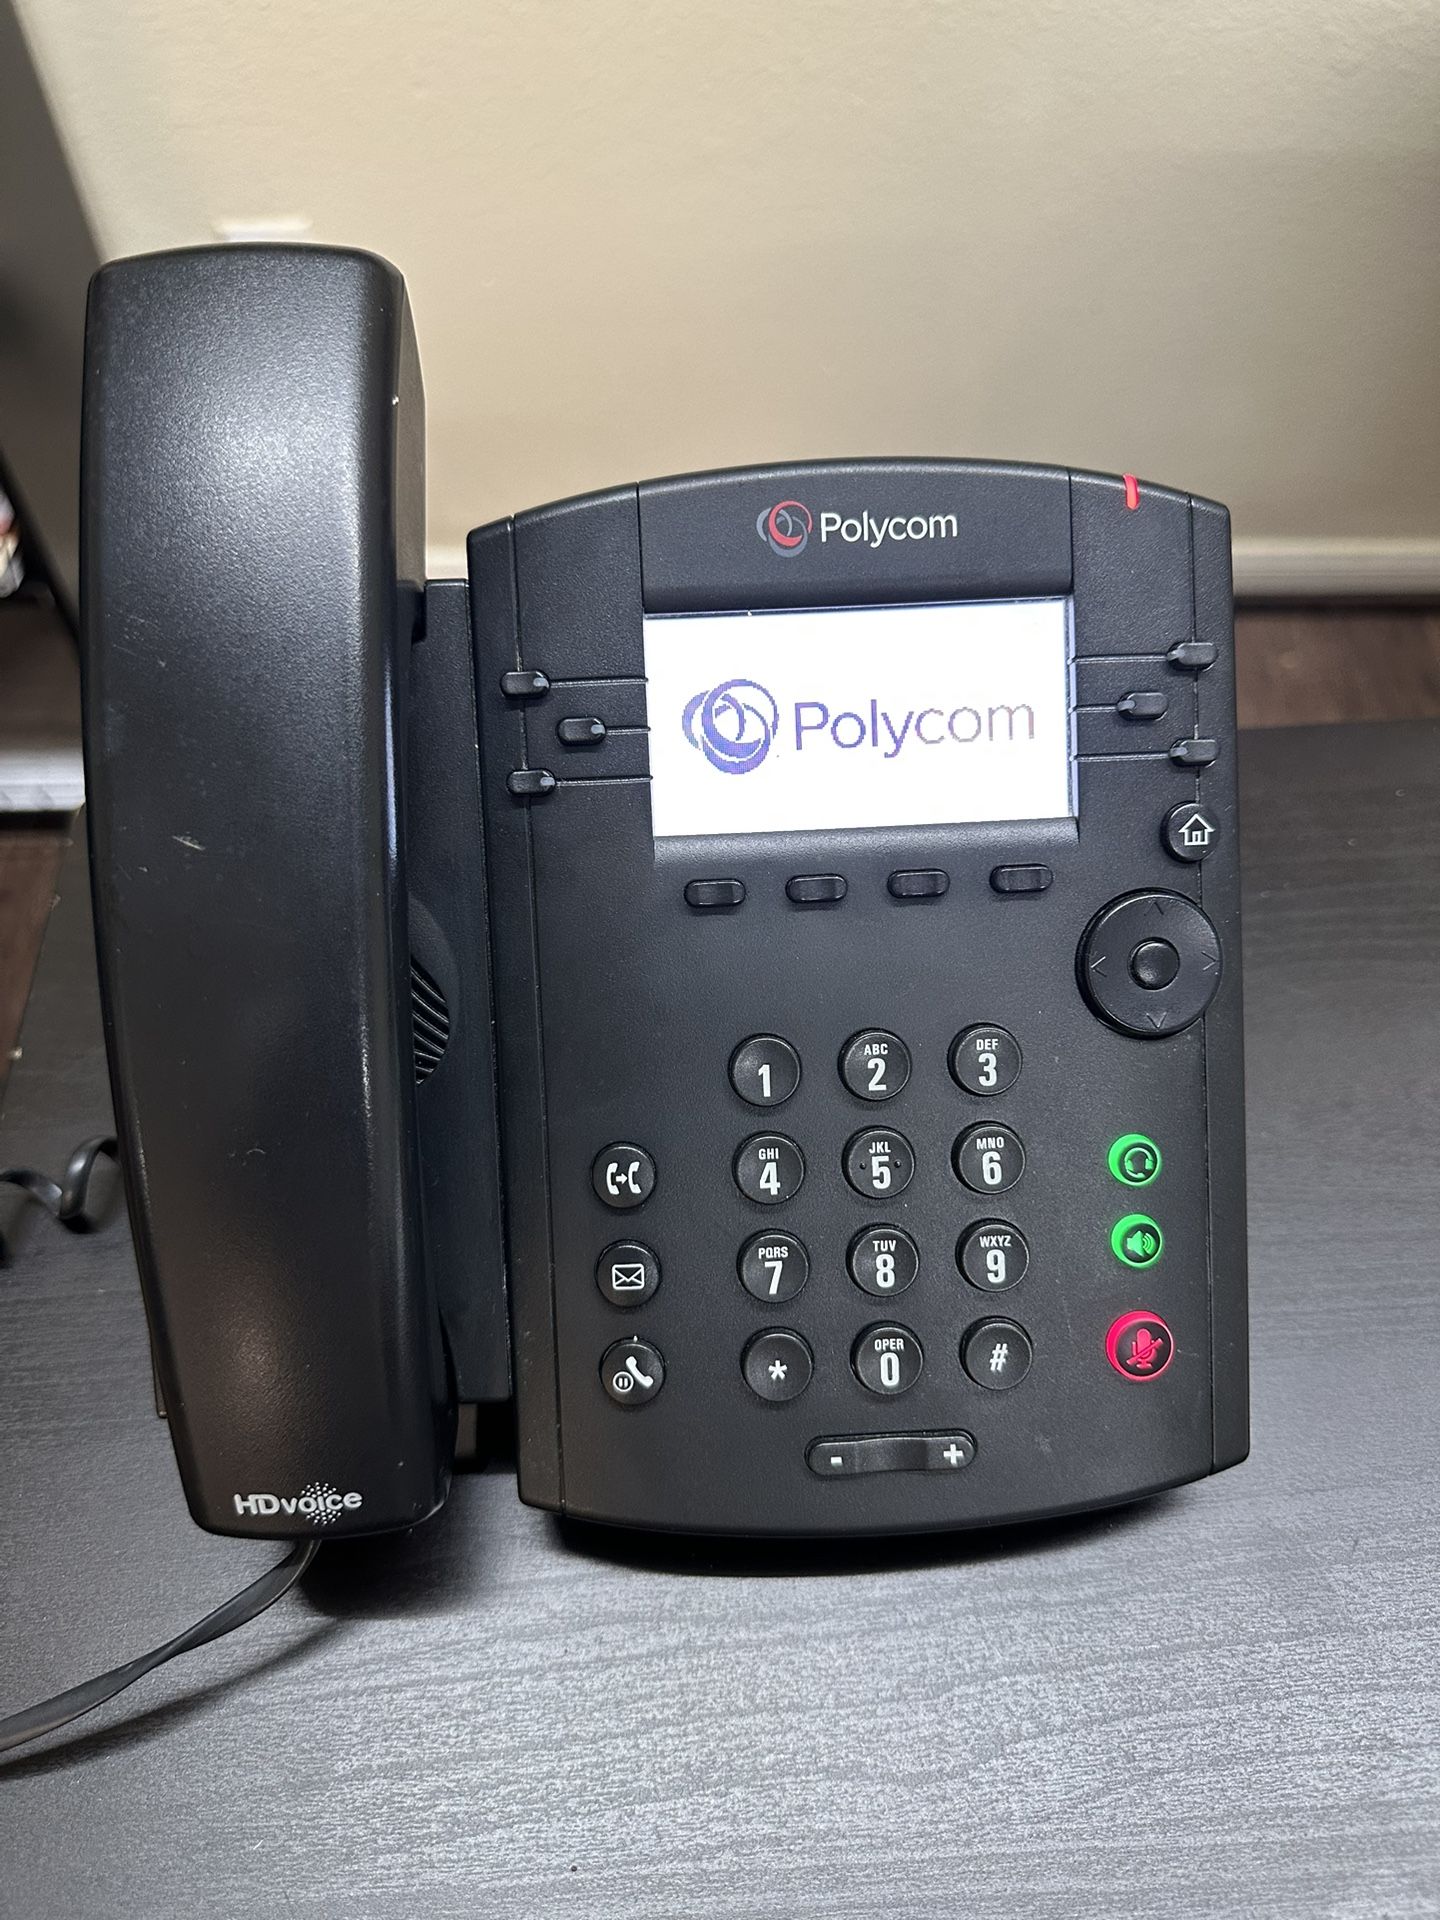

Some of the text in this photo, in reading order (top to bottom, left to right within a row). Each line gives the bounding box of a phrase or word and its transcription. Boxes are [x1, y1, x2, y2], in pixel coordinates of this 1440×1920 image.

[820, 510, 958, 548] Polycom
[794, 698, 1035, 759] Polycom
[864, 1044, 889, 1055] ABC
[976, 1039, 999, 1050] DEF
[758, 1064, 771, 1097] 1
[867, 1057, 887, 1091] 2
[978, 1052, 998, 1087] 3
[758, 1148, 779, 1160] GHI
[868, 1141, 891, 1154] JKL
[976, 1137, 1005, 1149] MNO
[759, 1162, 781, 1196] 4
[871, 1155, 891, 1189] 5
[981, 1151, 1002, 1185] 6
[758, 1246, 789, 1259] PQRS
[873, 1240, 897, 1252] TUV
[979, 1235, 1011, 1248] WXYZ
[764, 1261, 783, 1295] 7
[875, 1253, 895, 1288] 8
[986, 1249, 1006, 1283] 9
[874, 1338, 904, 1351] OPER
[880, 1352, 900, 1387] 0
